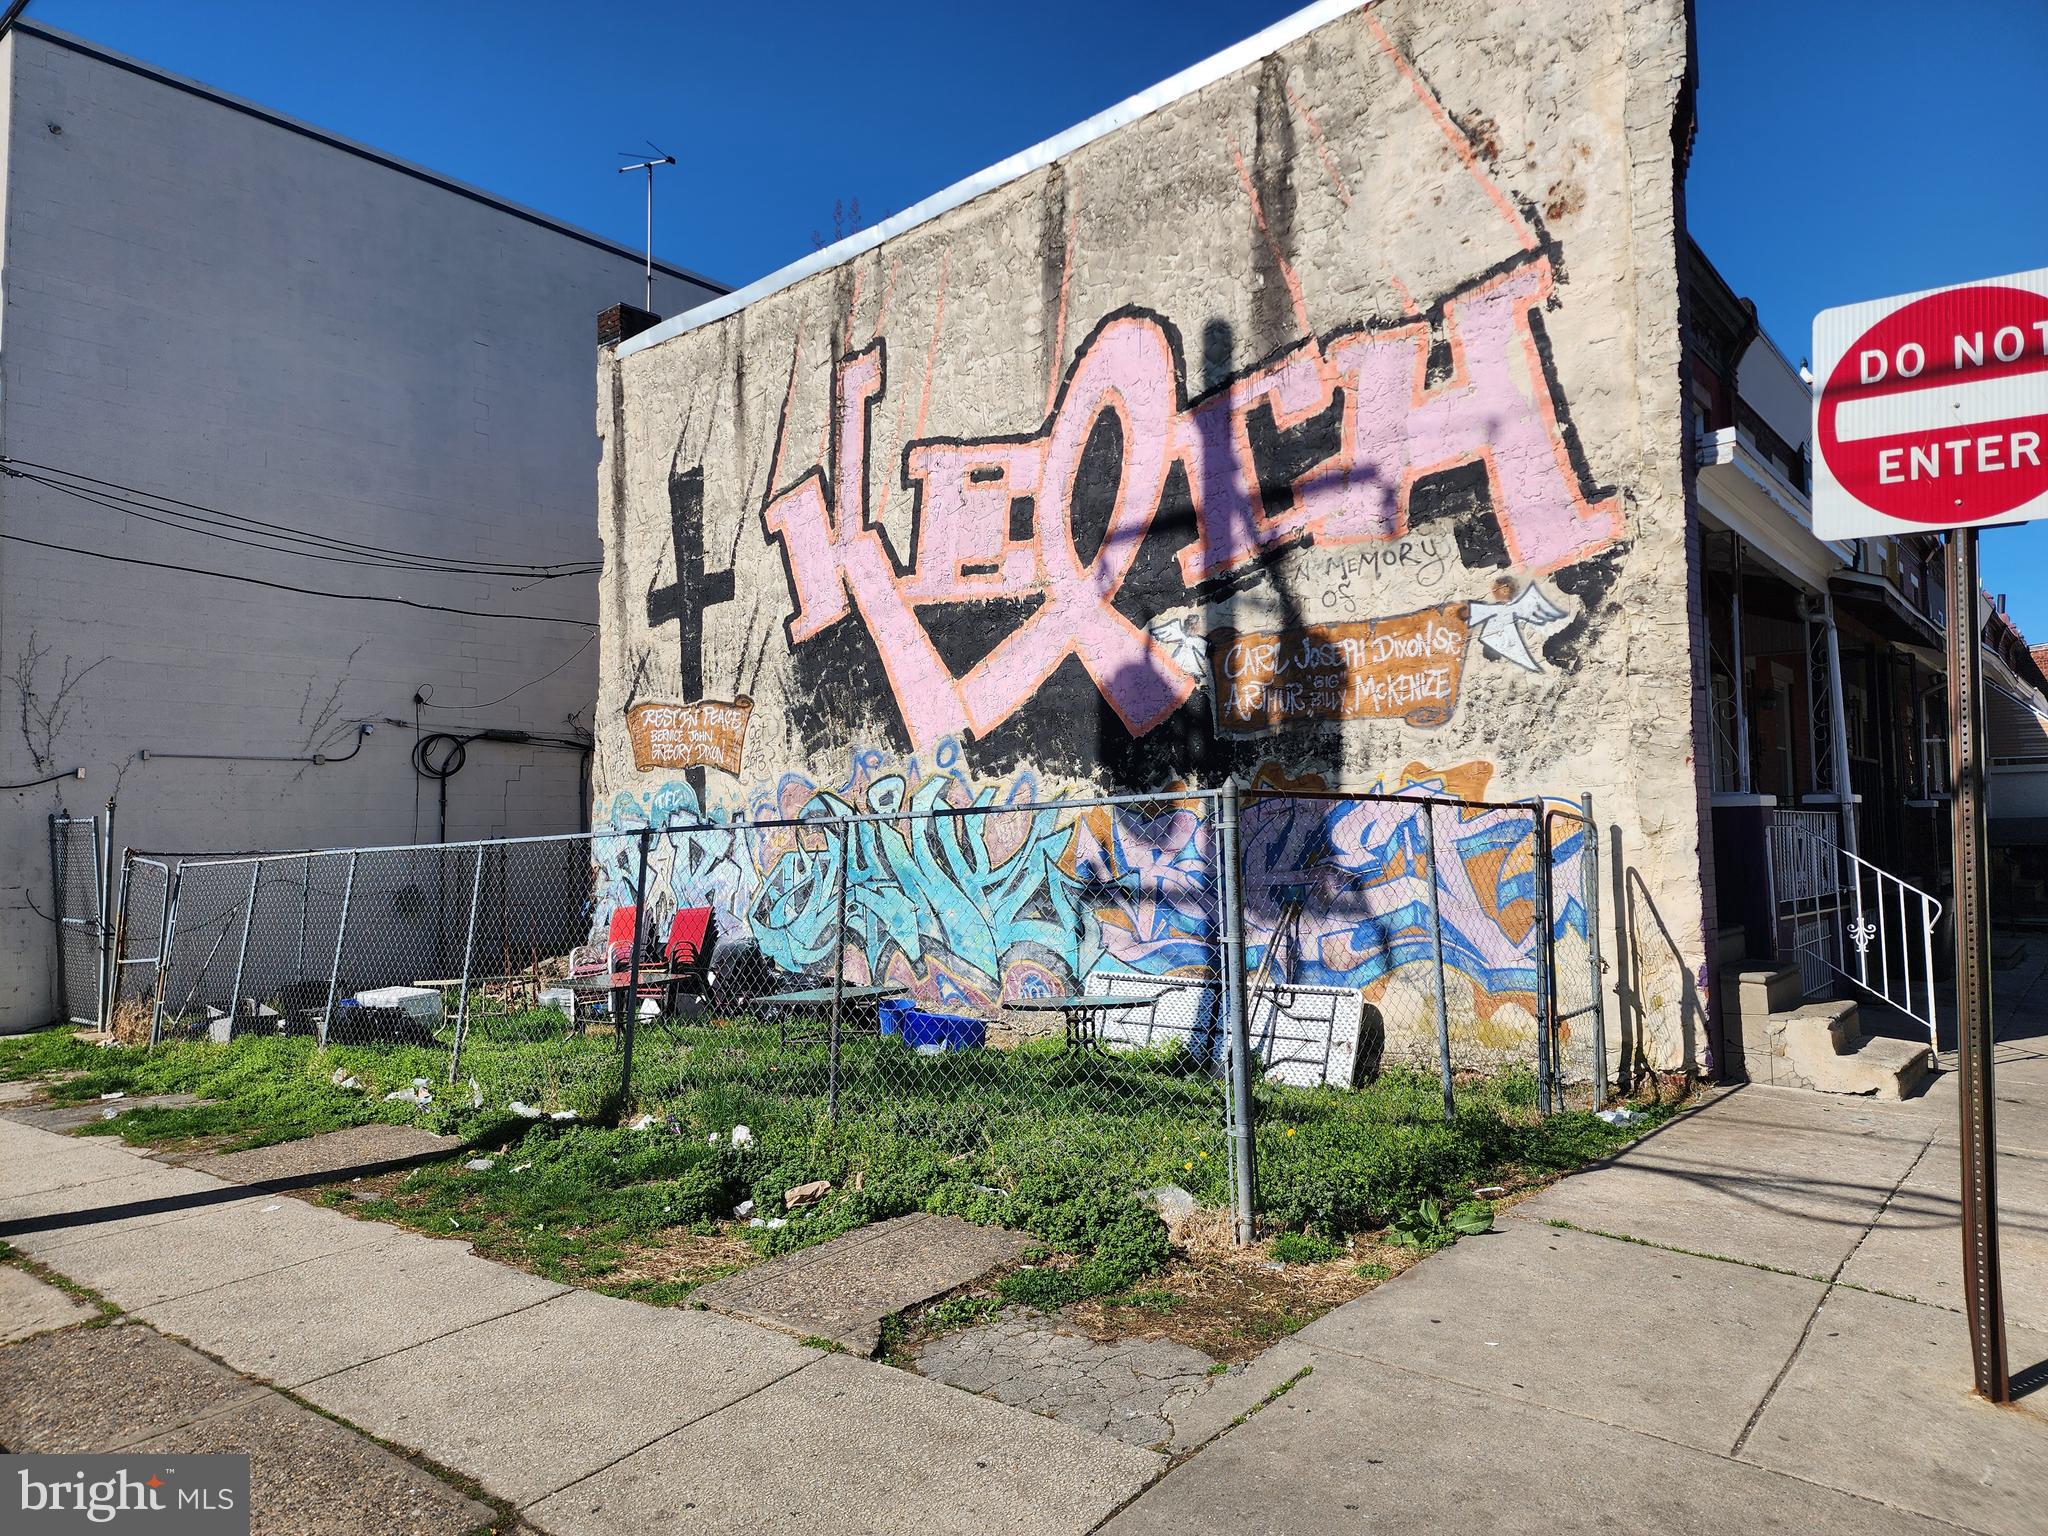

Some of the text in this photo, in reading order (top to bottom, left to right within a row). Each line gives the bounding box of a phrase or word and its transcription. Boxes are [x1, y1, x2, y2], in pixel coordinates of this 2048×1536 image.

[1860, 342, 1925, 385] DO
[1878, 431, 2041, 485] ENTER
[1325, 538, 1447, 587] MEMORY
[1224, 642, 1289, 679] CARL
[641, 706, 742, 729] REST IN PEACE
[1224, 680, 1305, 721] ARTHUR
[651, 740, 725, 766] GREGORY DIXON
[689, 730, 713, 743] JOHN
